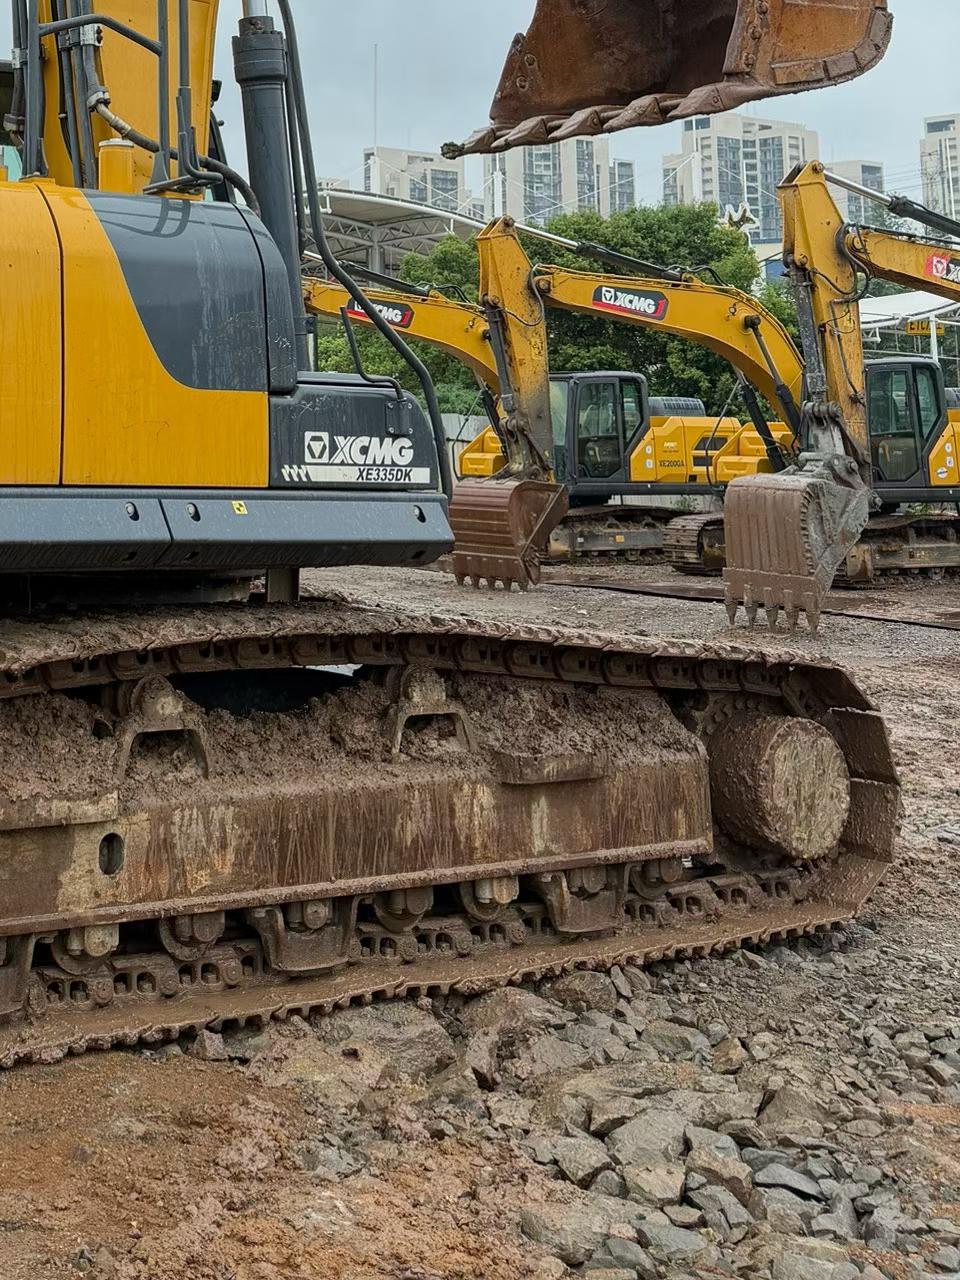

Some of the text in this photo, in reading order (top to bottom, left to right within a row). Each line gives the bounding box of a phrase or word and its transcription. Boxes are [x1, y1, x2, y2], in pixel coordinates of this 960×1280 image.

[370, 302, 402, 323] CMG
[614, 291, 656, 314] XCMG
[329, 435, 414, 466] XCMG
[356, 467, 413, 482] XE335DK
